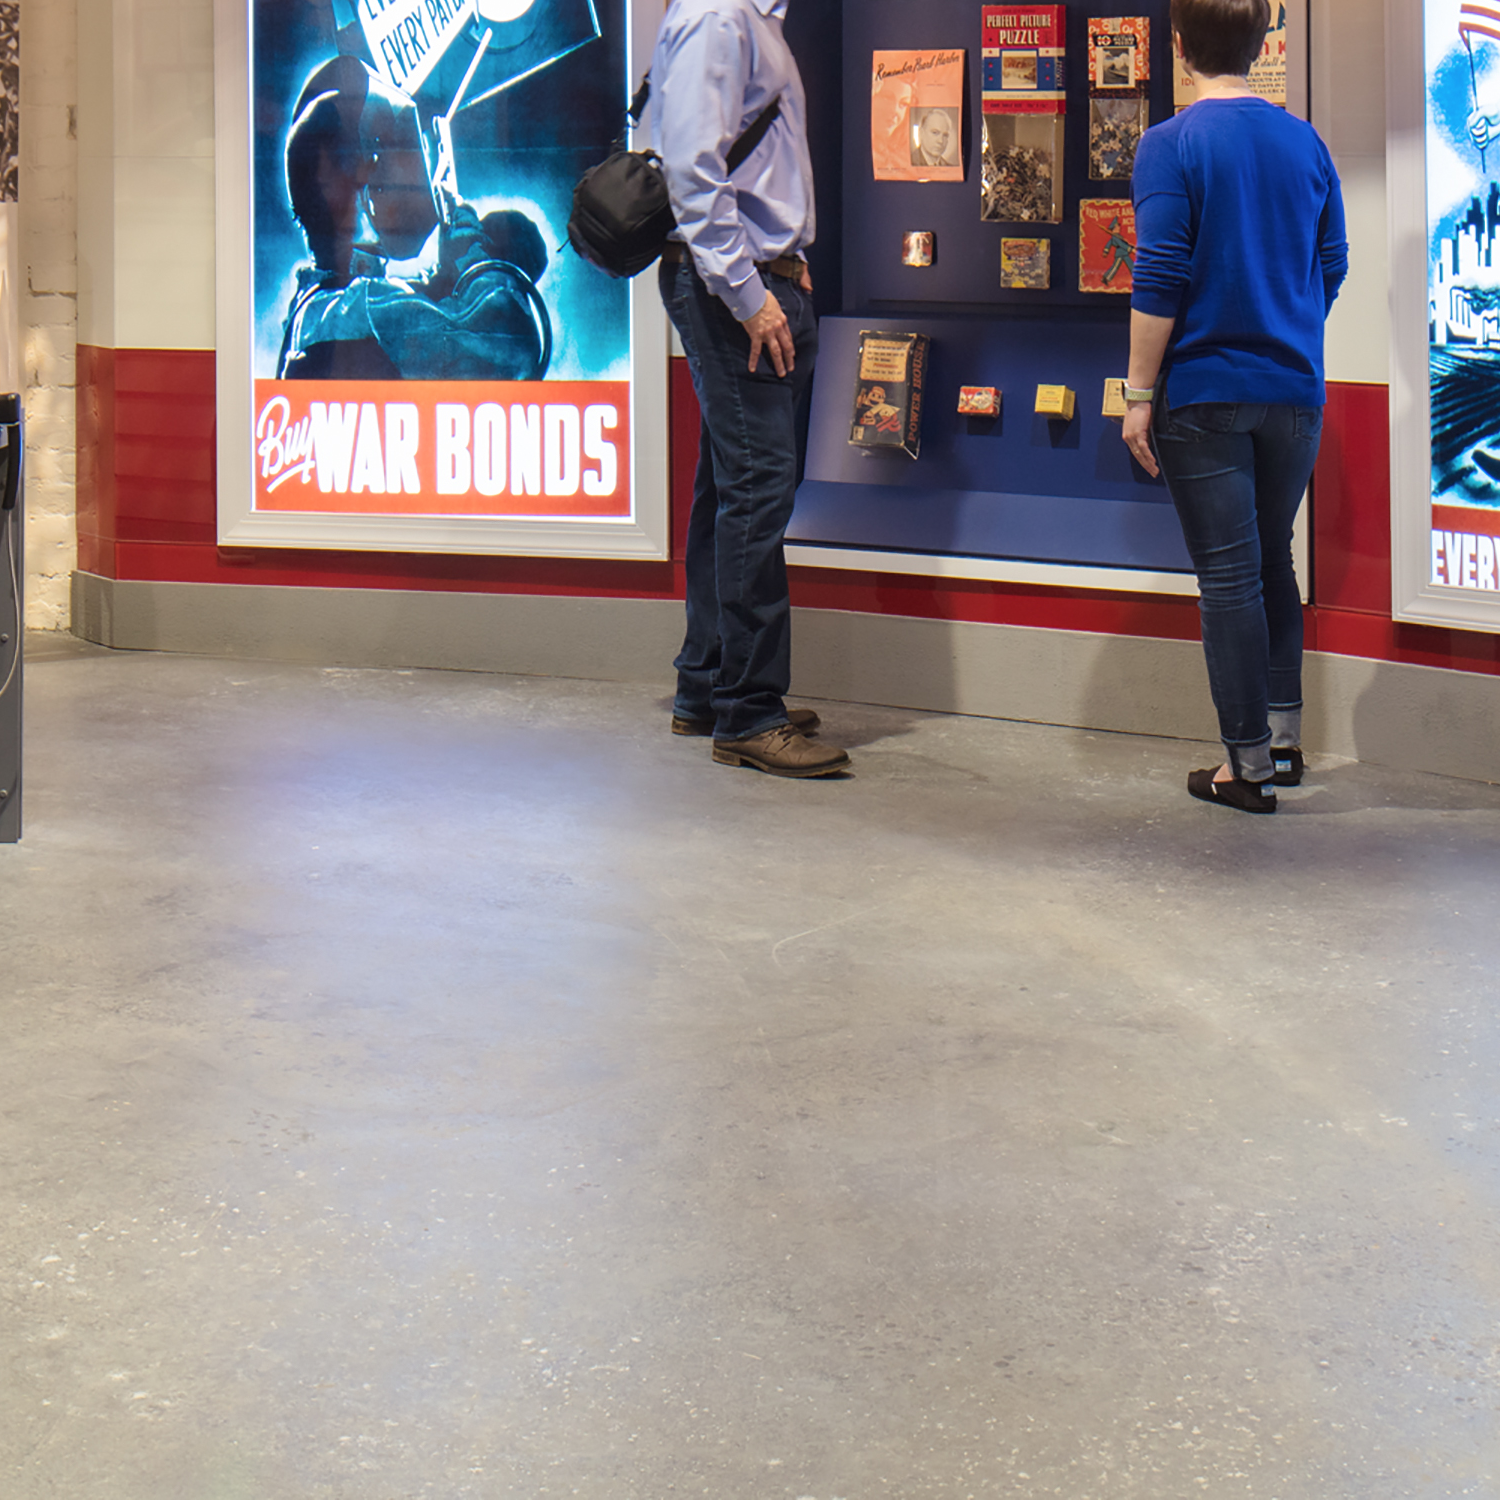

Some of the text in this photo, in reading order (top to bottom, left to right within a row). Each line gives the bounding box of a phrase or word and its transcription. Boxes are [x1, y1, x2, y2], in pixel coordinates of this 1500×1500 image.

[986, 14, 1051, 28] PERFECT PICTURE
[999, 29, 1040, 46] PUZZLE
[379, 8, 428, 88] EVERY
[256, 395, 618, 497] Buy WAR BONDS
